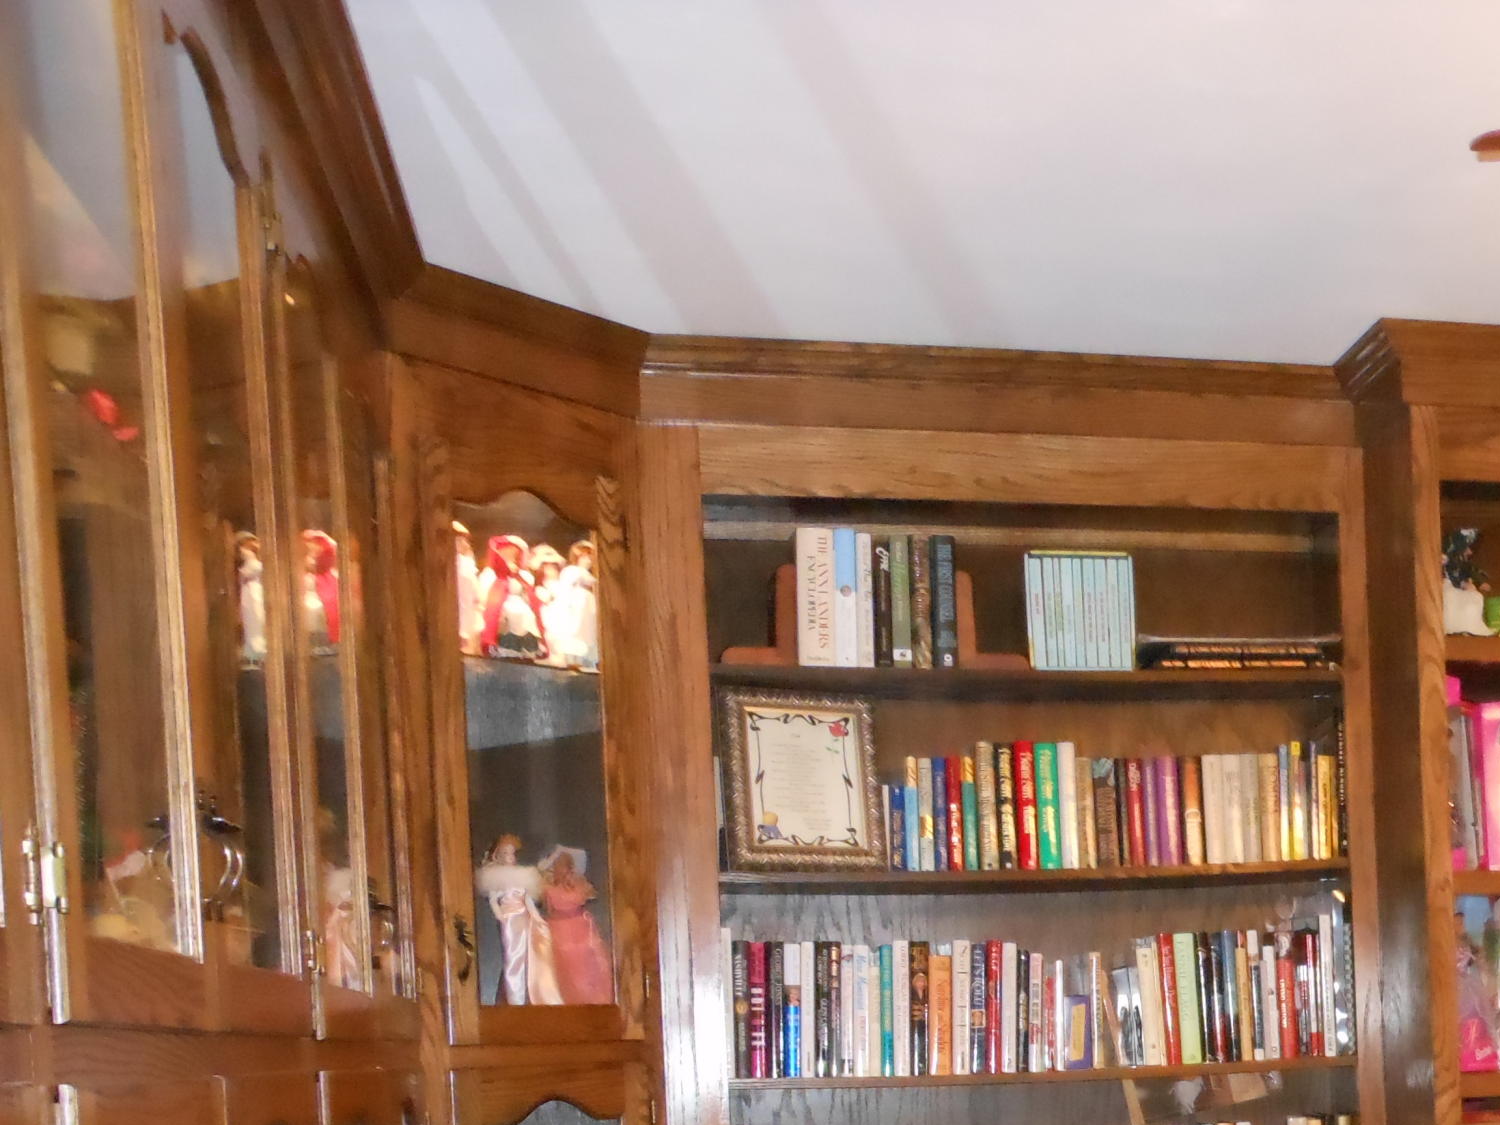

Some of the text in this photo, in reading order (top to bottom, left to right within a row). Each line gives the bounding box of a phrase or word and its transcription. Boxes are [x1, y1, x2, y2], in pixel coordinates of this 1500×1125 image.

[817, 537, 827, 553] THE
[807, 556, 817, 631] ENCYCLOPEDIA
[818, 589, 830, 648] LANDERS
